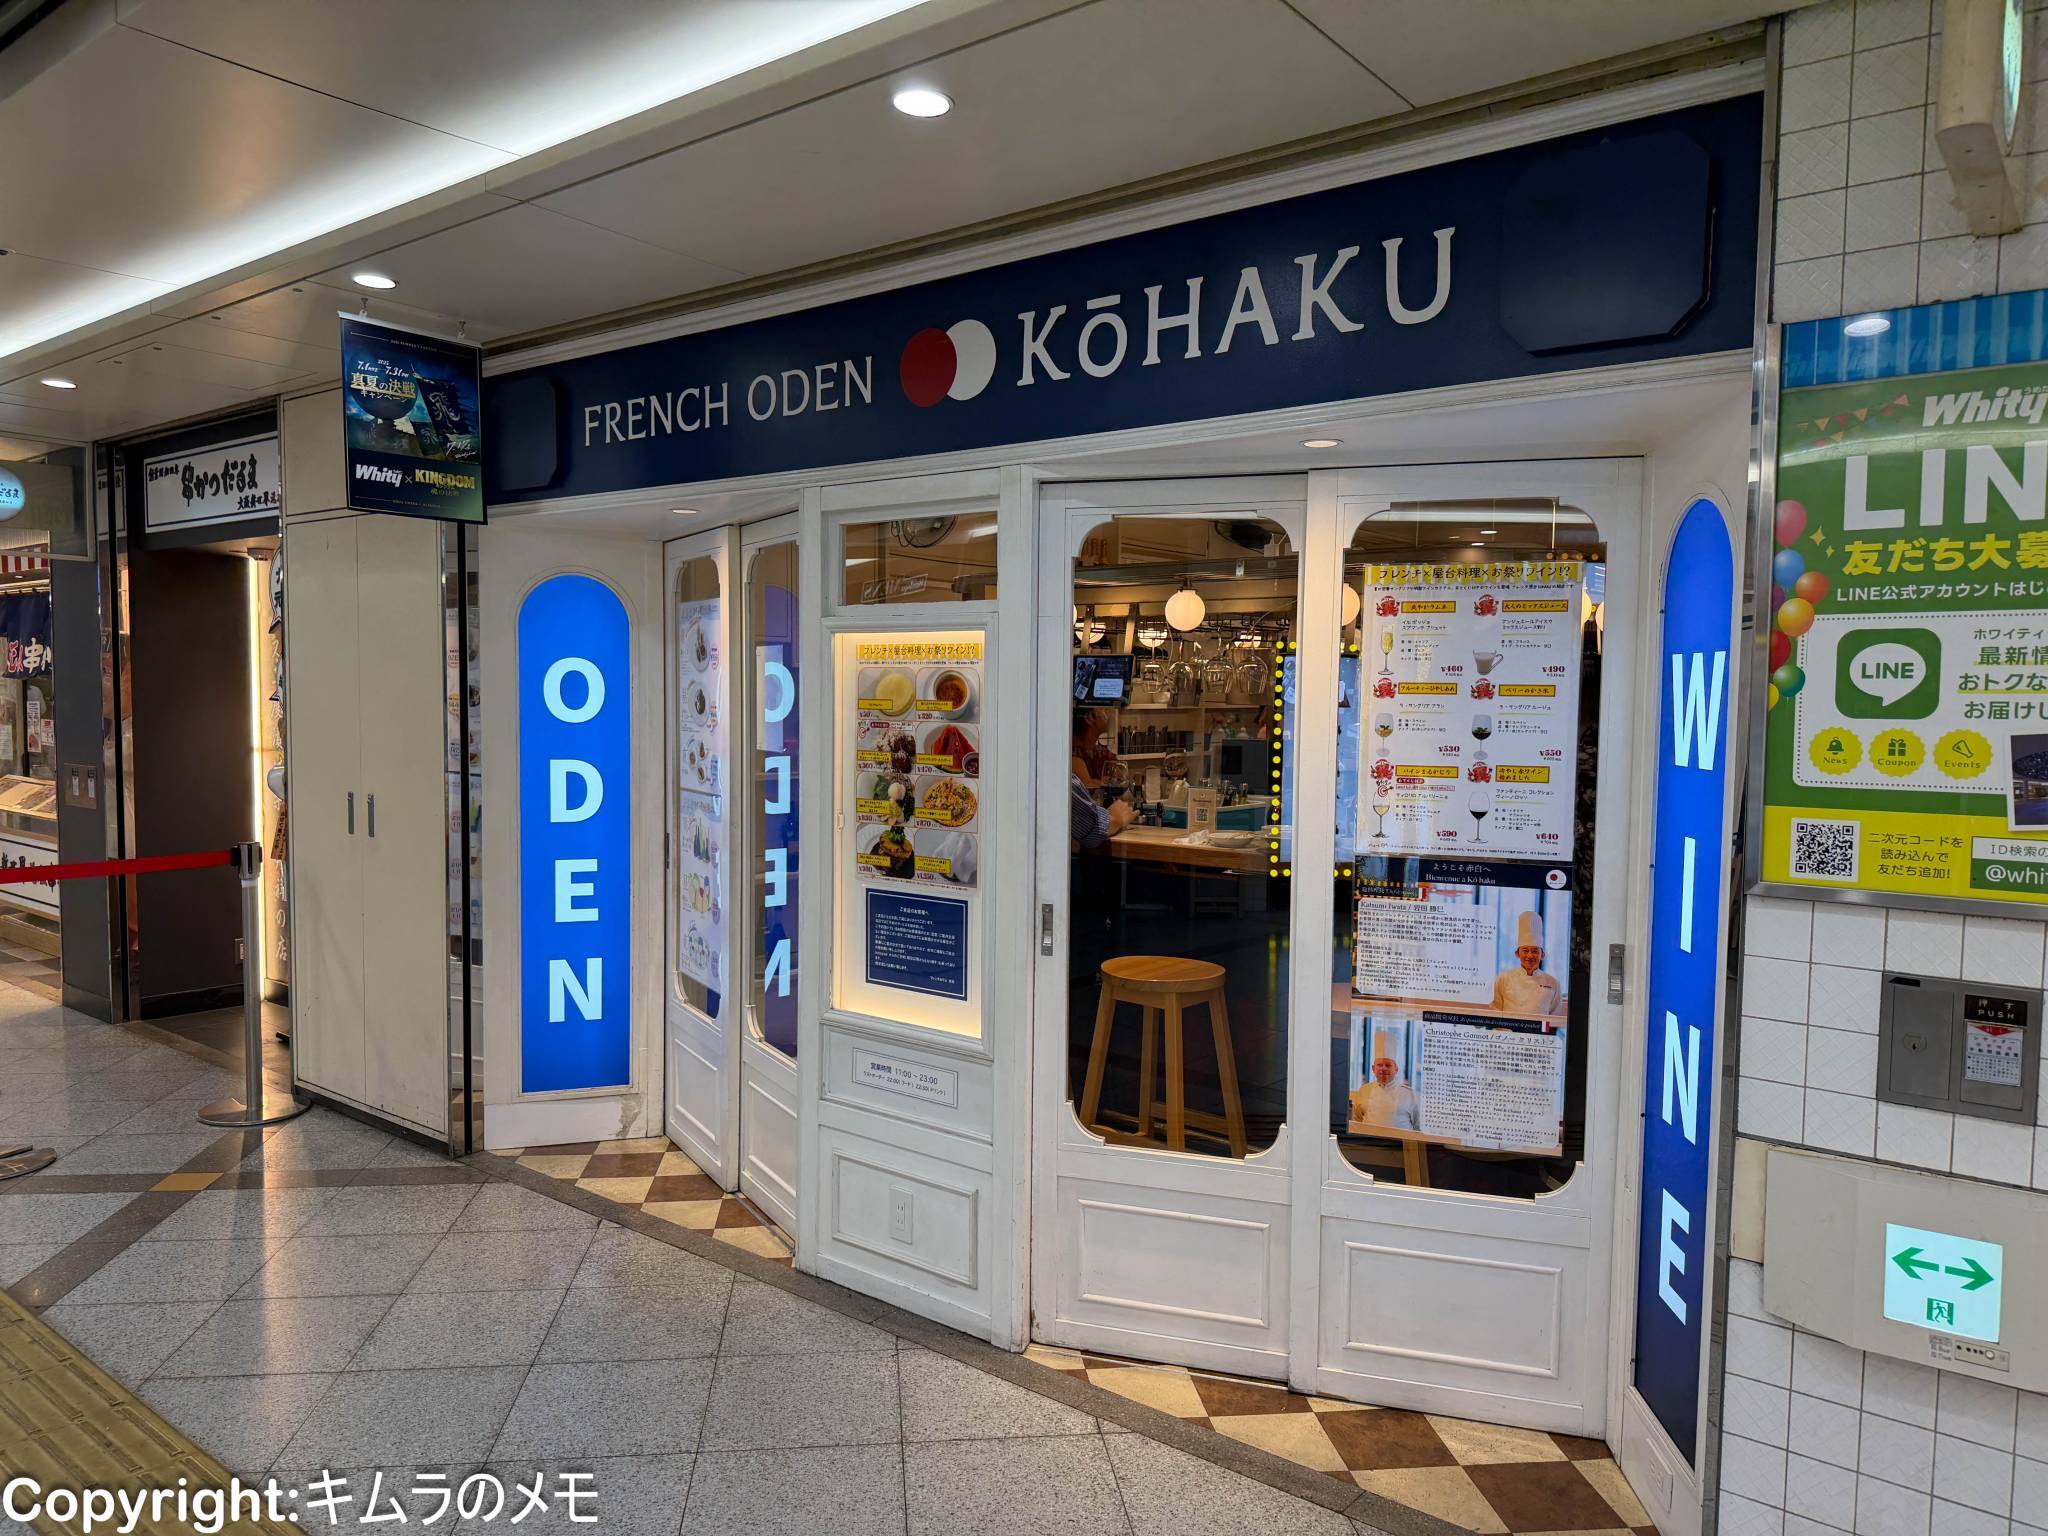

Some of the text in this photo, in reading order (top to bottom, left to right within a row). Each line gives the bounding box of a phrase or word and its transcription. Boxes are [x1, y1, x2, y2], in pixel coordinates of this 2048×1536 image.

[351, 373, 416, 395] 真夏の決戦
[584, 381, 731, 447] FRENCH
[746, 355, 873, 422] ODEN
[1922, 386, 2048, 428] Whity
[181, 453, 258, 507] 串かつだるま
[355, 463, 403, 488] Whity
[415, 469, 476, 490] KINGDOM
[1836, 580, 2048, 605] LINE公式アカウントはじ
[1973, 628, 2044, 642] ホワイティ
[1978, 645, 2048, 666] 最新情
[1860, 661, 1915, 681] LINE
[1958, 672, 2048, 692] おトクな
[1823, 756, 1981, 769] News Coupon Events
[542, 656, 605, 1023] ODEN
[1868, 832, 1963, 849] 二次元コードを
[1880, 848, 1949, 864] 読み込んで
[1360, 901, 1387, 909] Katsumi
[1658, 650, 1726, 1326] WINE
[1978, 1009, 2015, 1020] PUSH
[1425, 1028, 1461, 1039] Christophe
